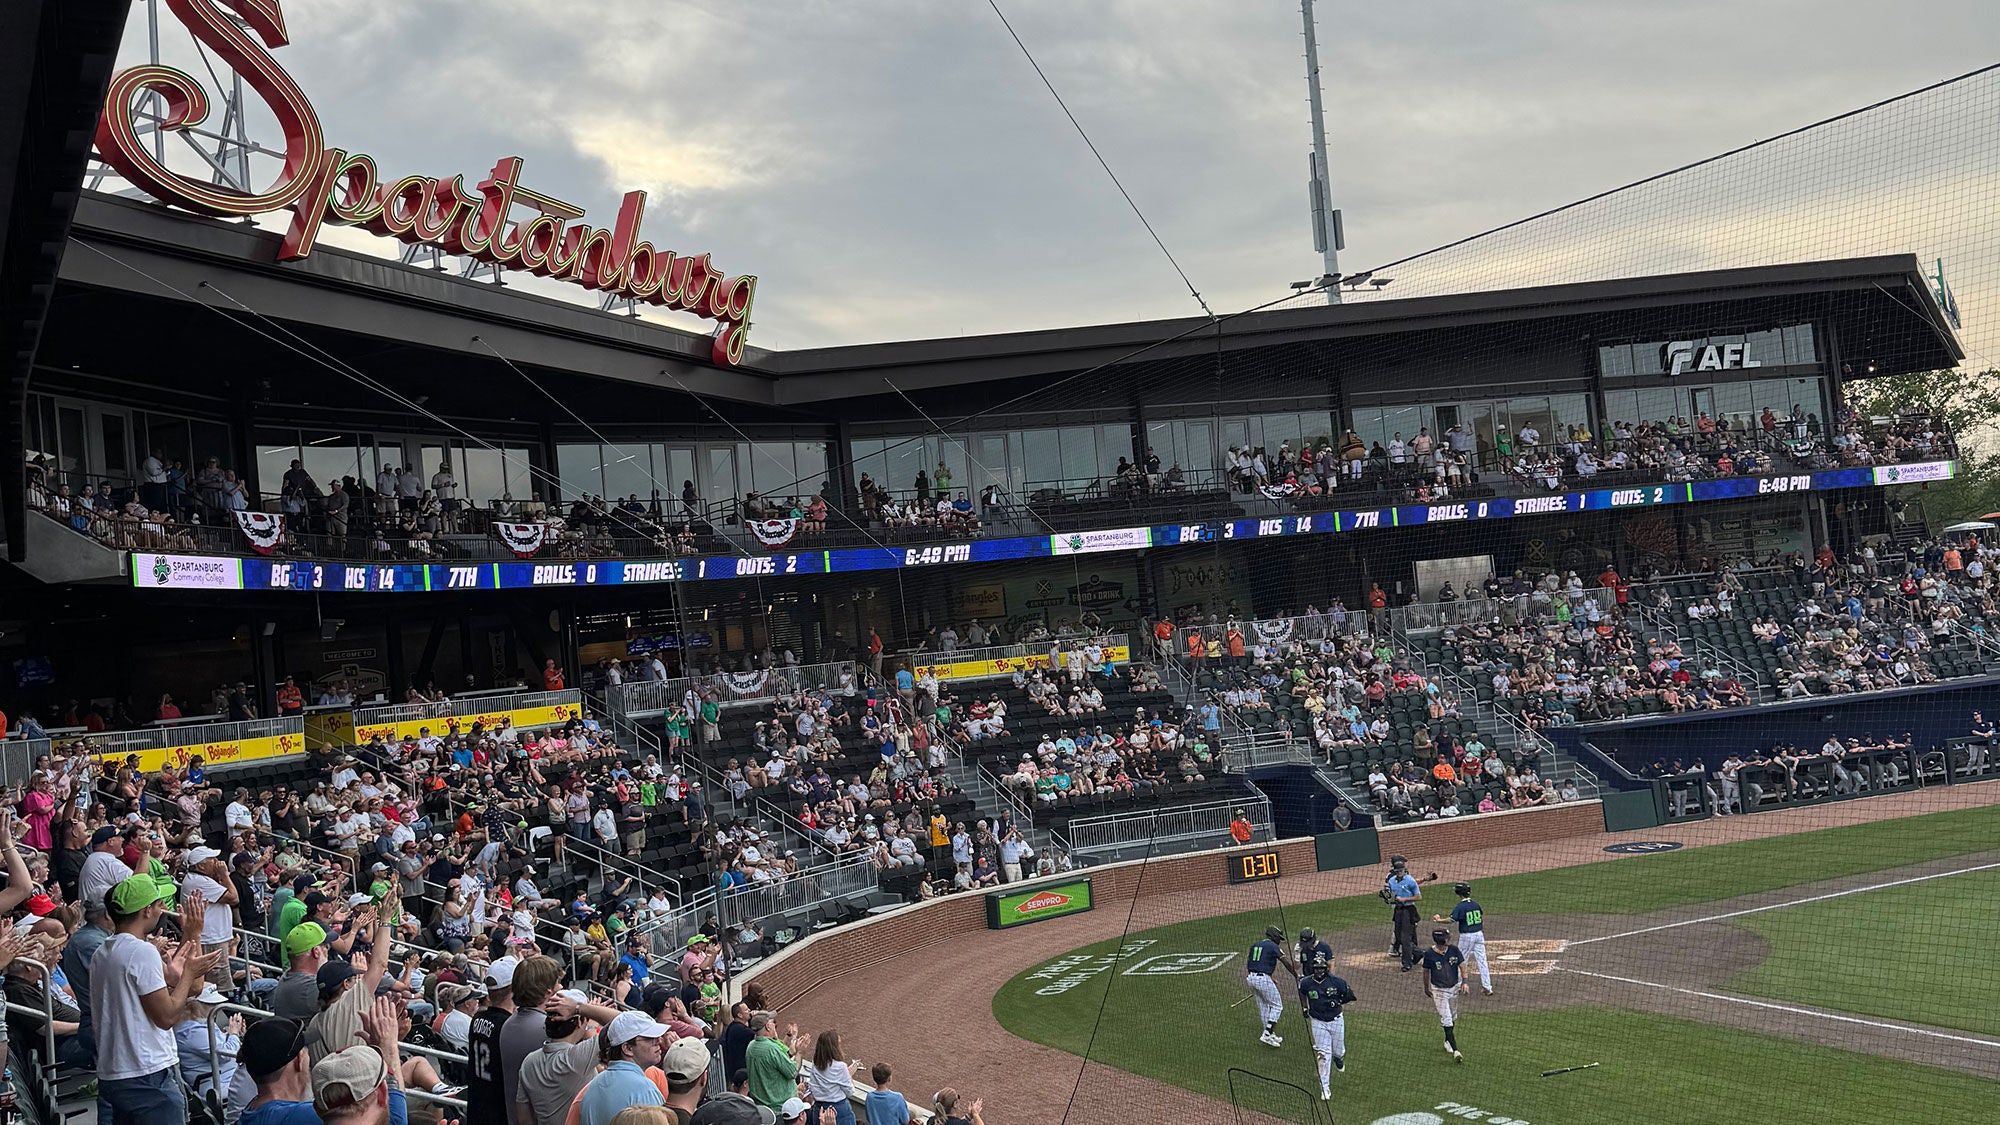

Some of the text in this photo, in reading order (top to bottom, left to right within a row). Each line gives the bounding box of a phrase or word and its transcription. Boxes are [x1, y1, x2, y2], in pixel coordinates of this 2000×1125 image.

[95, 0, 758, 367] Spartanburg
[1697, 342, 1761, 372] AFL
[1758, 475, 1811, 494] 6:48 PM
[1514, 494, 1586, 515] STRIKES: 1
[1611, 487, 1663, 506] OUTS: 2
[1354, 511, 1380, 529] 7TH
[1427, 502, 1488, 522] BALLS: 0
[1179, 522, 1234, 543] BG 3
[1258, 516, 1312, 536] HCS 14
[1085, 532, 1134, 544] SPARTANBURG
[736, 555, 797, 576] OUTS: 2
[904, 544, 971, 566] 6:48 PM
[172, 561, 224, 573] SPARTANBURG
[270, 564, 323, 588] BG 3
[448, 567, 478, 588] 7TH
[532, 564, 597, 585] BALLS: 0
[623, 560, 706, 582] STRIKES: 1
[172, 571, 225, 585] Community College
[344, 567, 395, 589] HCS 14
[207, 743, 239, 761] Bojangles
[1242, 853, 1279, 878] 0:30
[1027, 895, 1062, 910] SERVPRO
[1252, 946, 1263, 961] 11
[473, 1039, 492, 1082] 12
